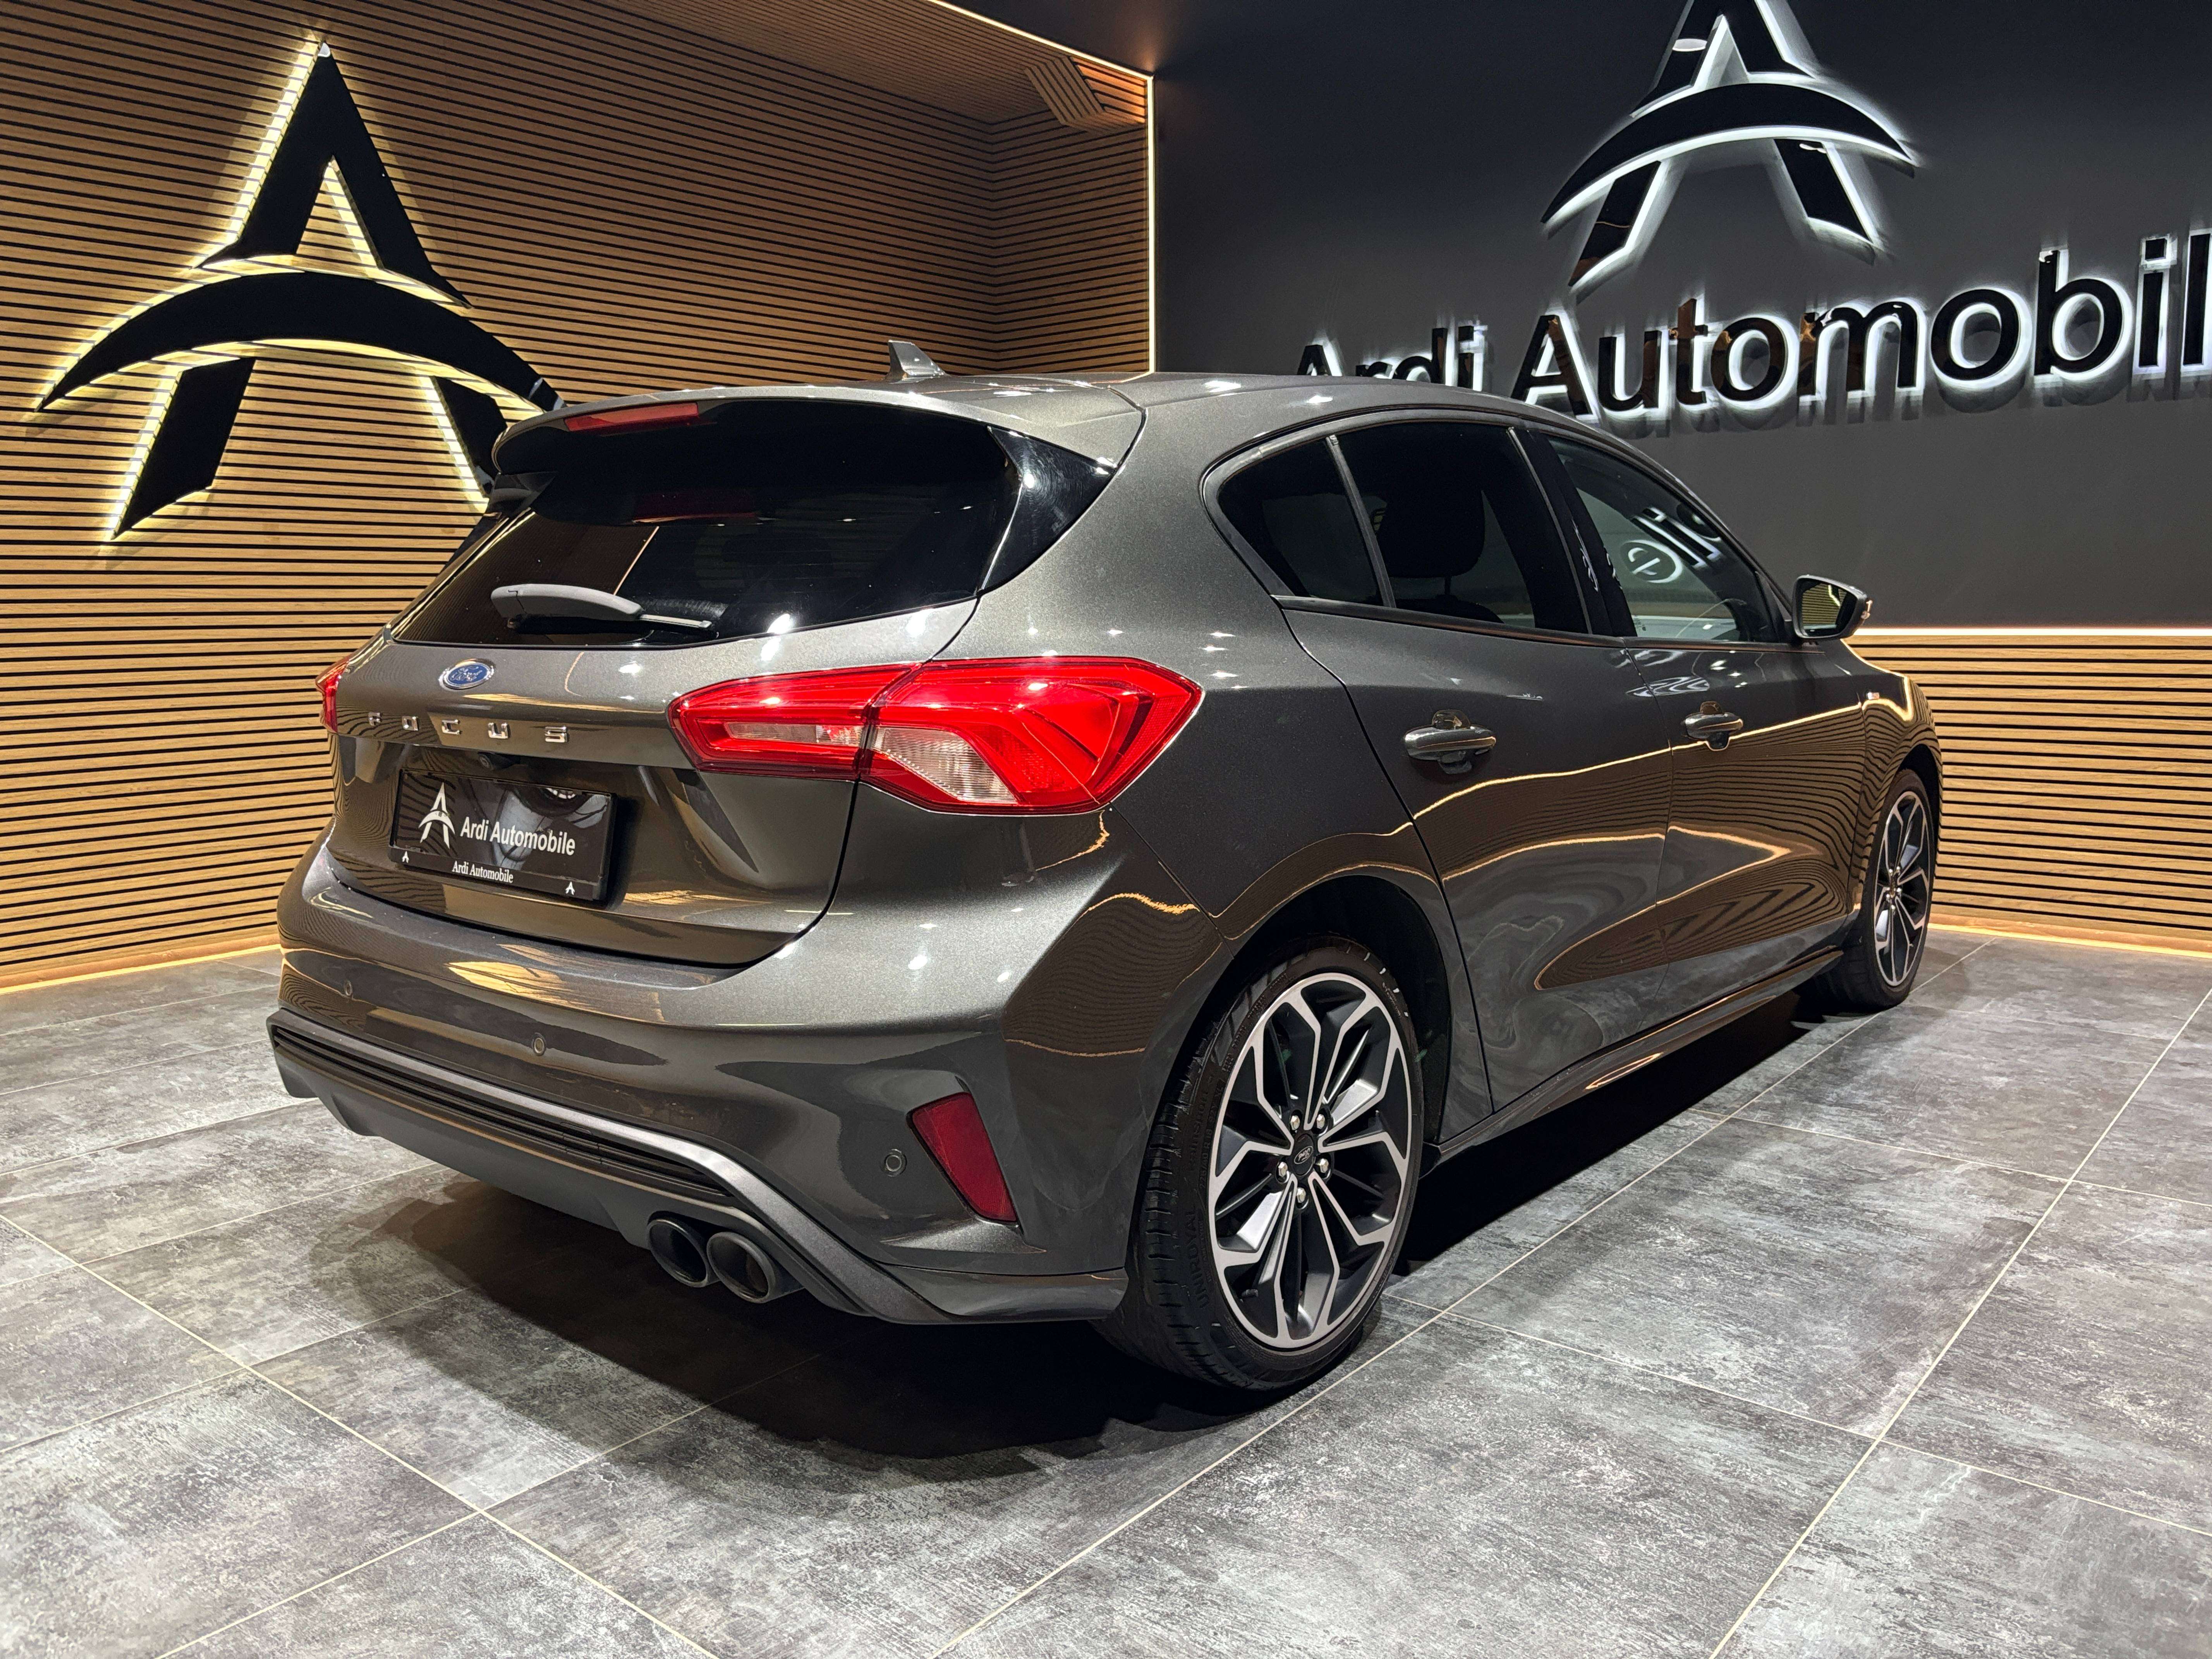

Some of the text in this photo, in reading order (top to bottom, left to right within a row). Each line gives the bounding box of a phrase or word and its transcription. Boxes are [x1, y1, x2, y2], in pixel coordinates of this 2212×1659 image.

[1297, 325, 1475, 390] di
[368, 712, 568, 743] FOCUS
[460, 816, 575, 855] Ardi Automobile
[452, 860, 514, 884] Ardi Automobile
